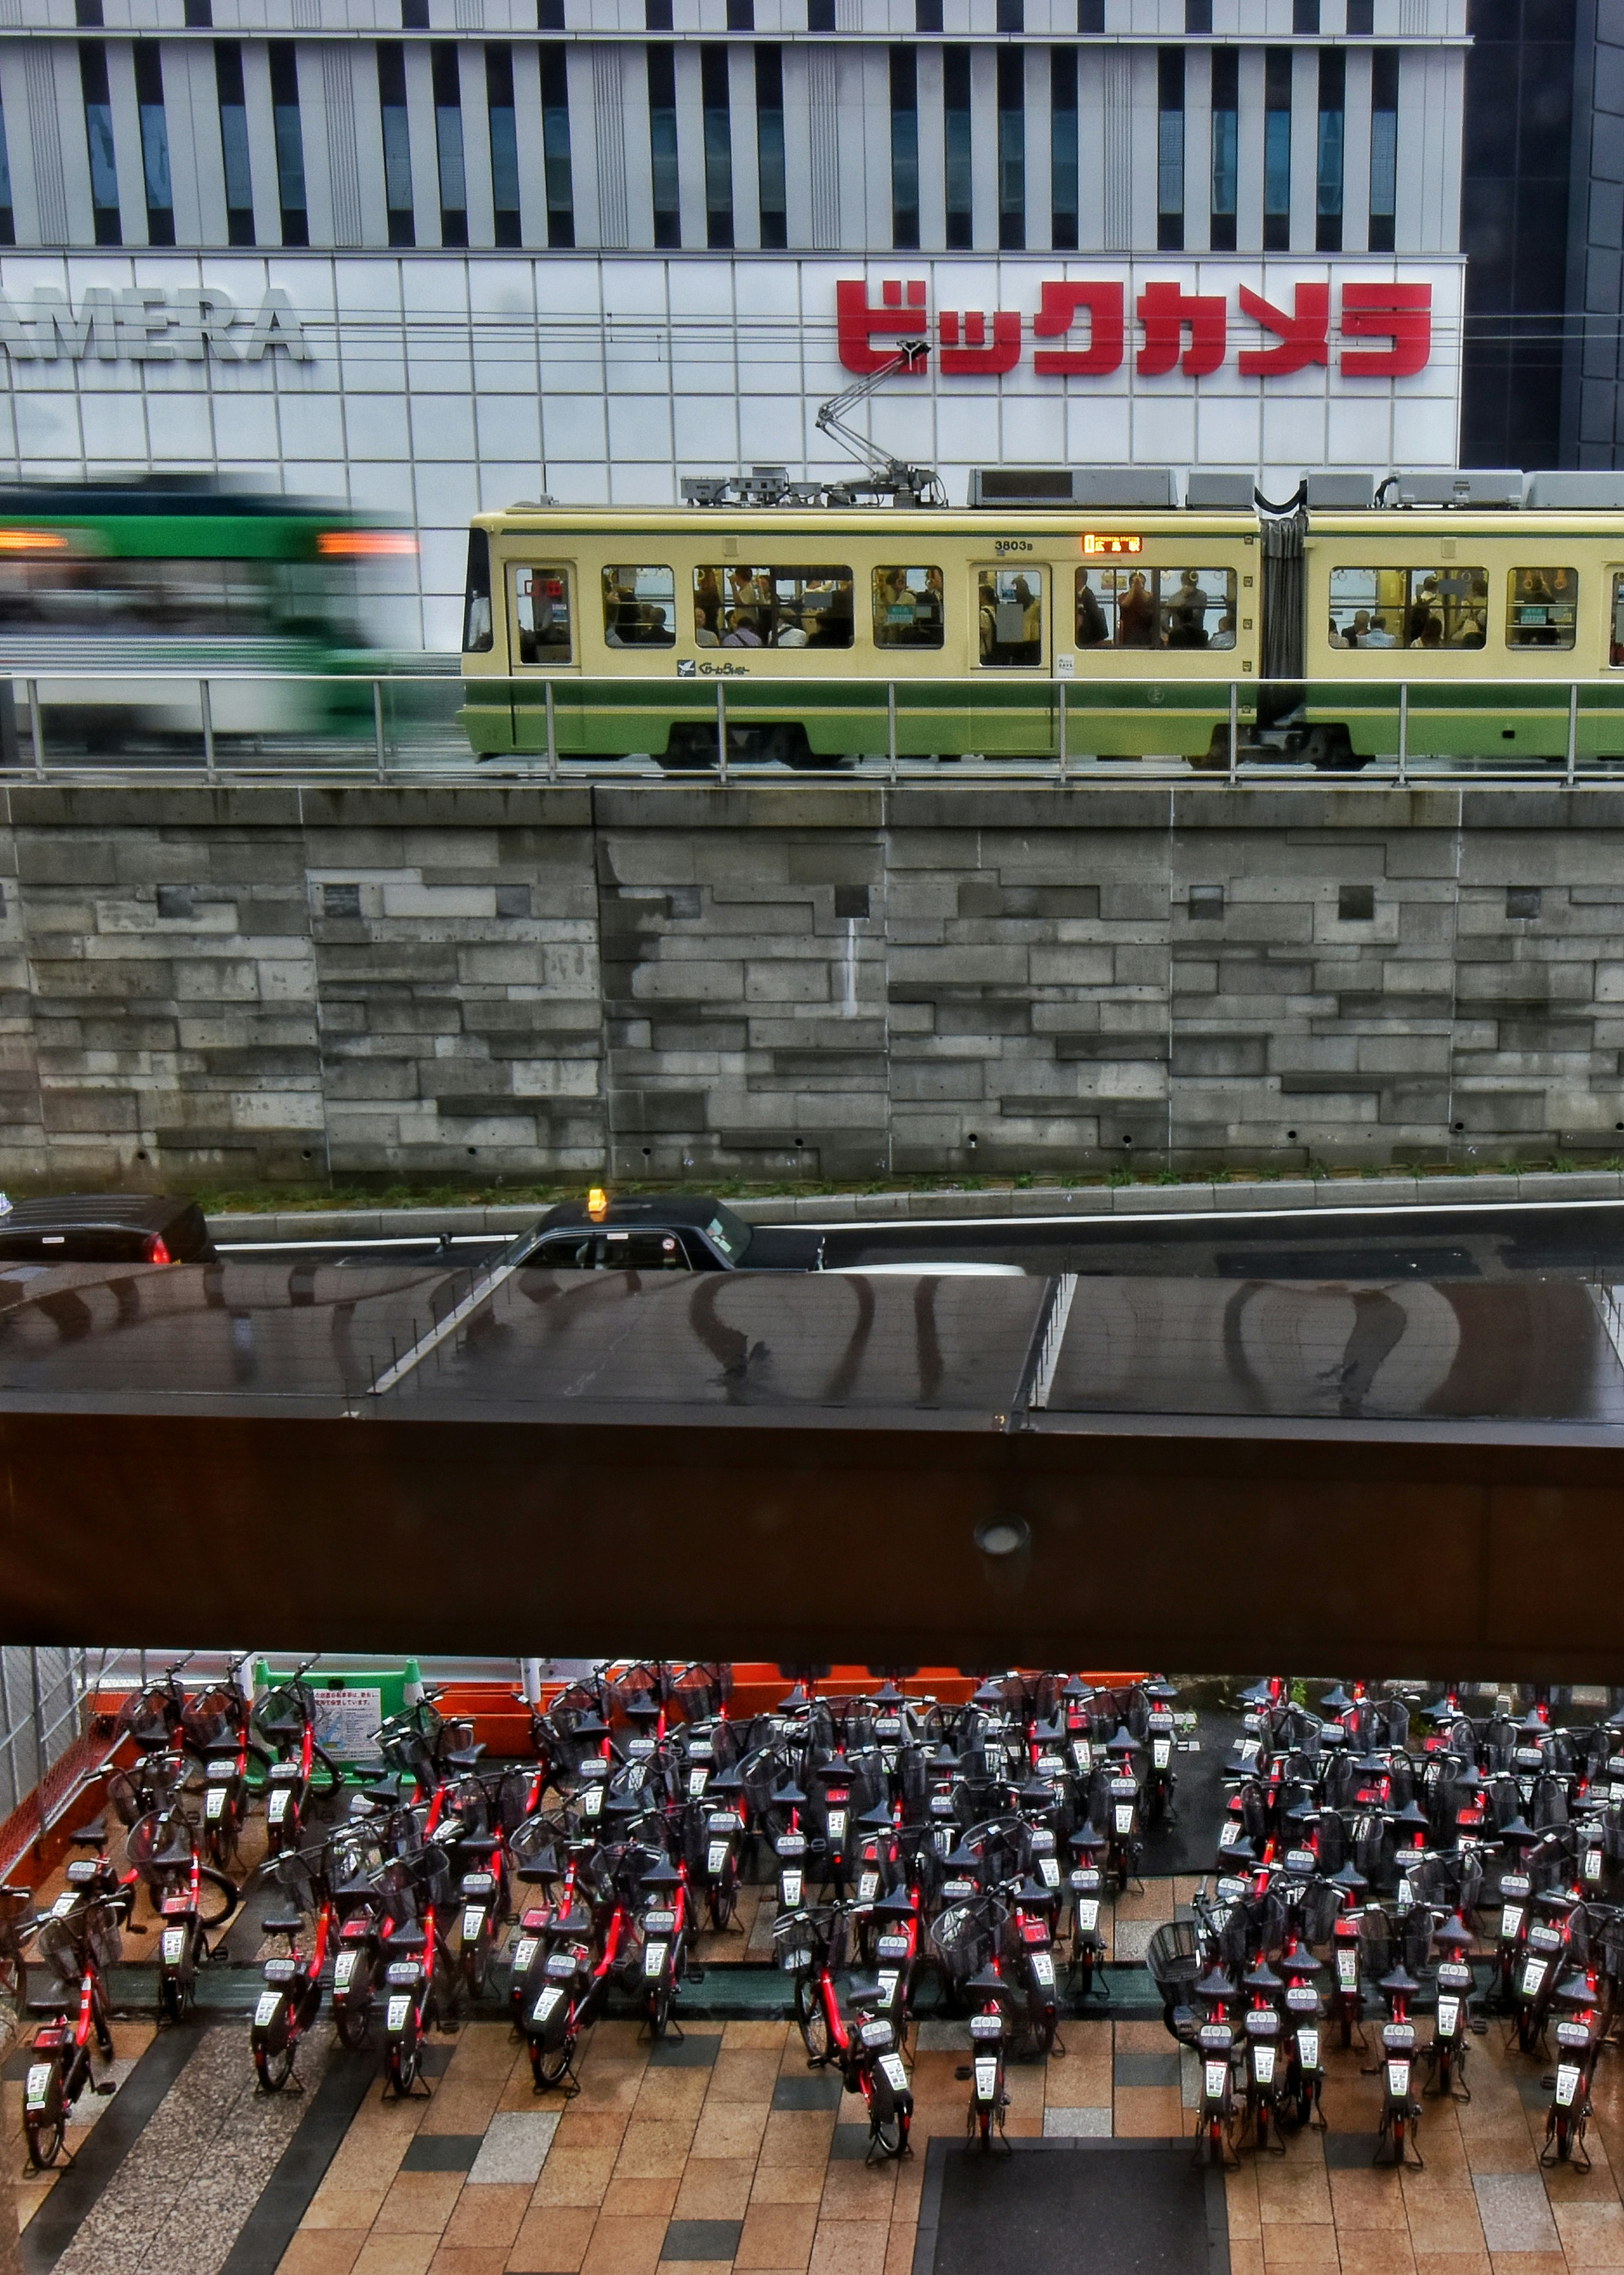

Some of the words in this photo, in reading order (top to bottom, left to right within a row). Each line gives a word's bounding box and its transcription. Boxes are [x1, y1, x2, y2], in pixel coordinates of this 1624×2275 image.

[836, 280, 1432, 376] ビックカメラ
